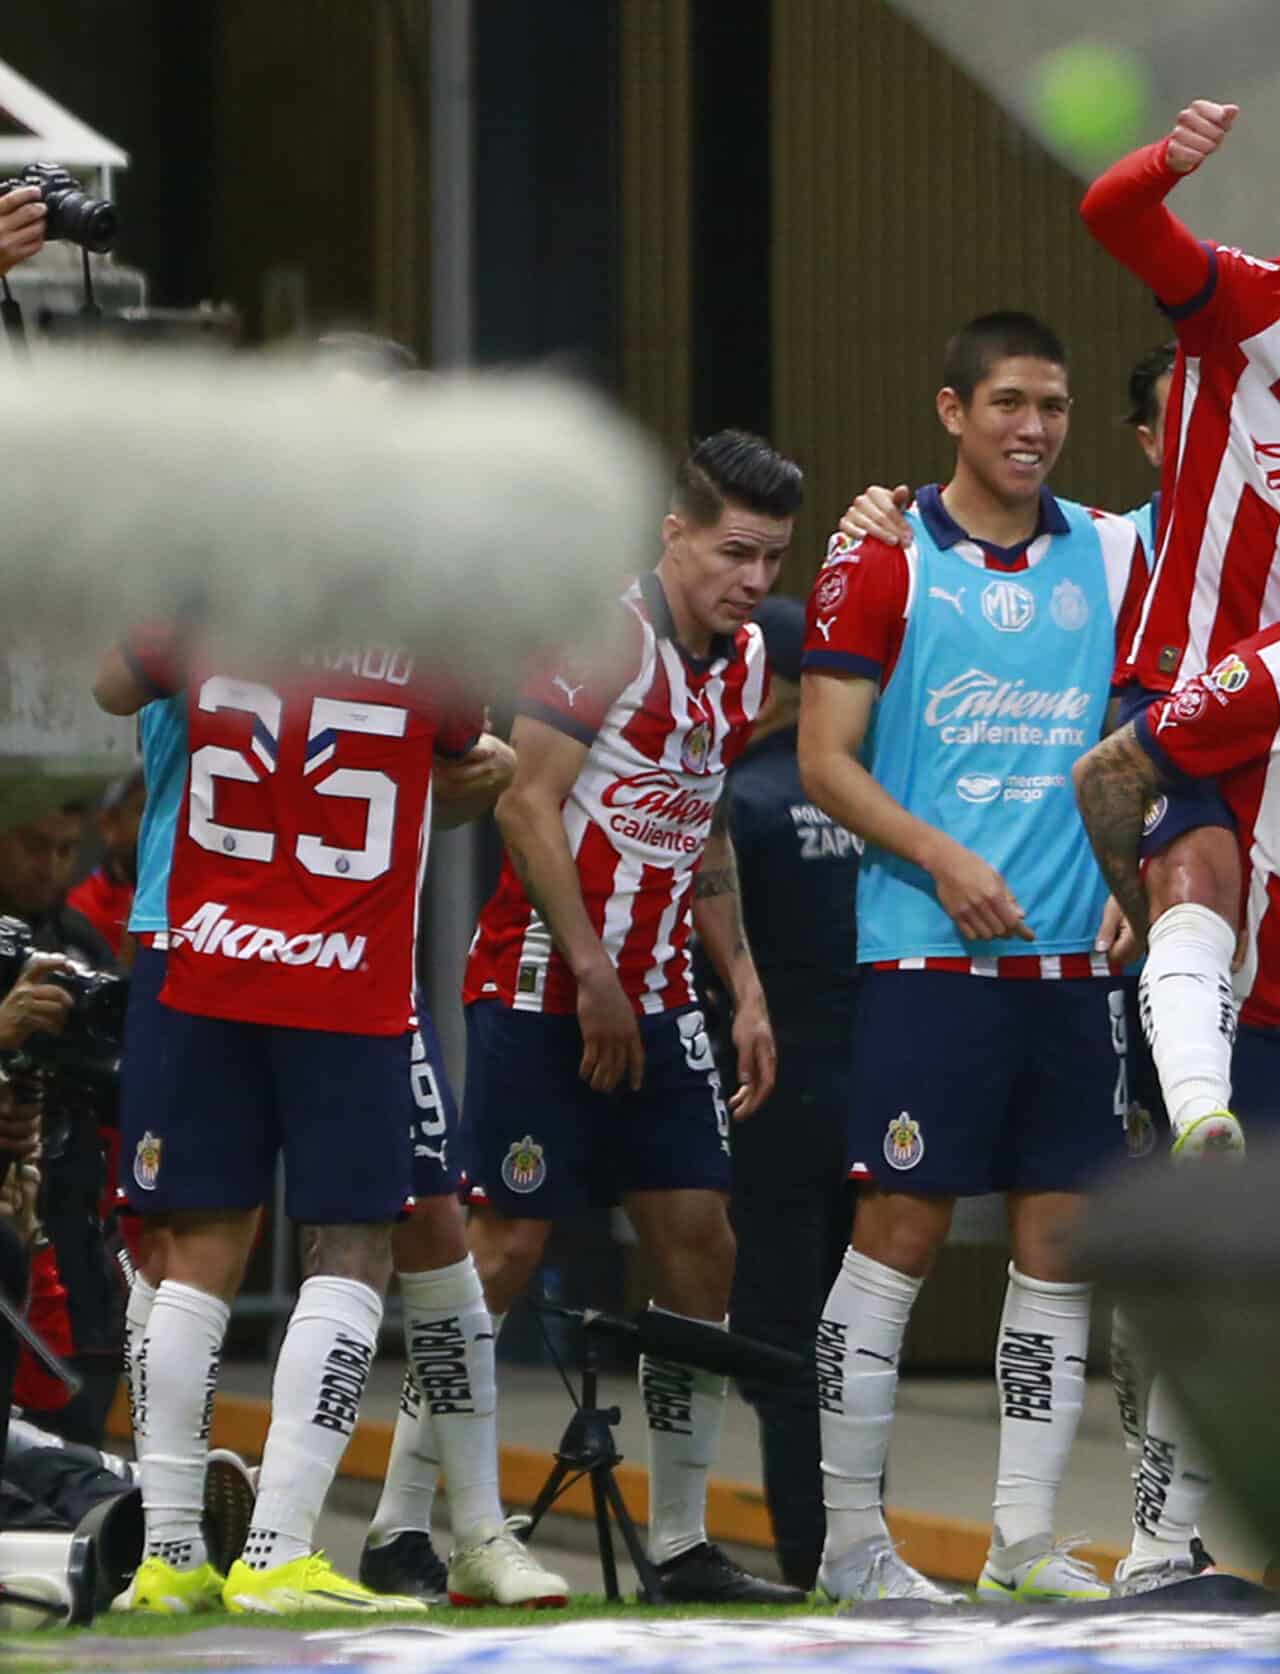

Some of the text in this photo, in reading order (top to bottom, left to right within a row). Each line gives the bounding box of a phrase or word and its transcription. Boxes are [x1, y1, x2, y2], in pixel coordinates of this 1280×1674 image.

[982, 582, 1034, 632] MG
[924, 668, 1092, 726] Caliente
[940, 720, 1084, 746] caliente.mx
[187, 676, 409, 882] 25
[171, 901, 367, 970] AKRON
[312, 1333, 373, 1436] PERDURA
[412, 1316, 475, 1414] PERDURA
[1001, 1327, 1055, 1423] PERDURA
[1136, 1435, 1176, 1537] PERDURA
